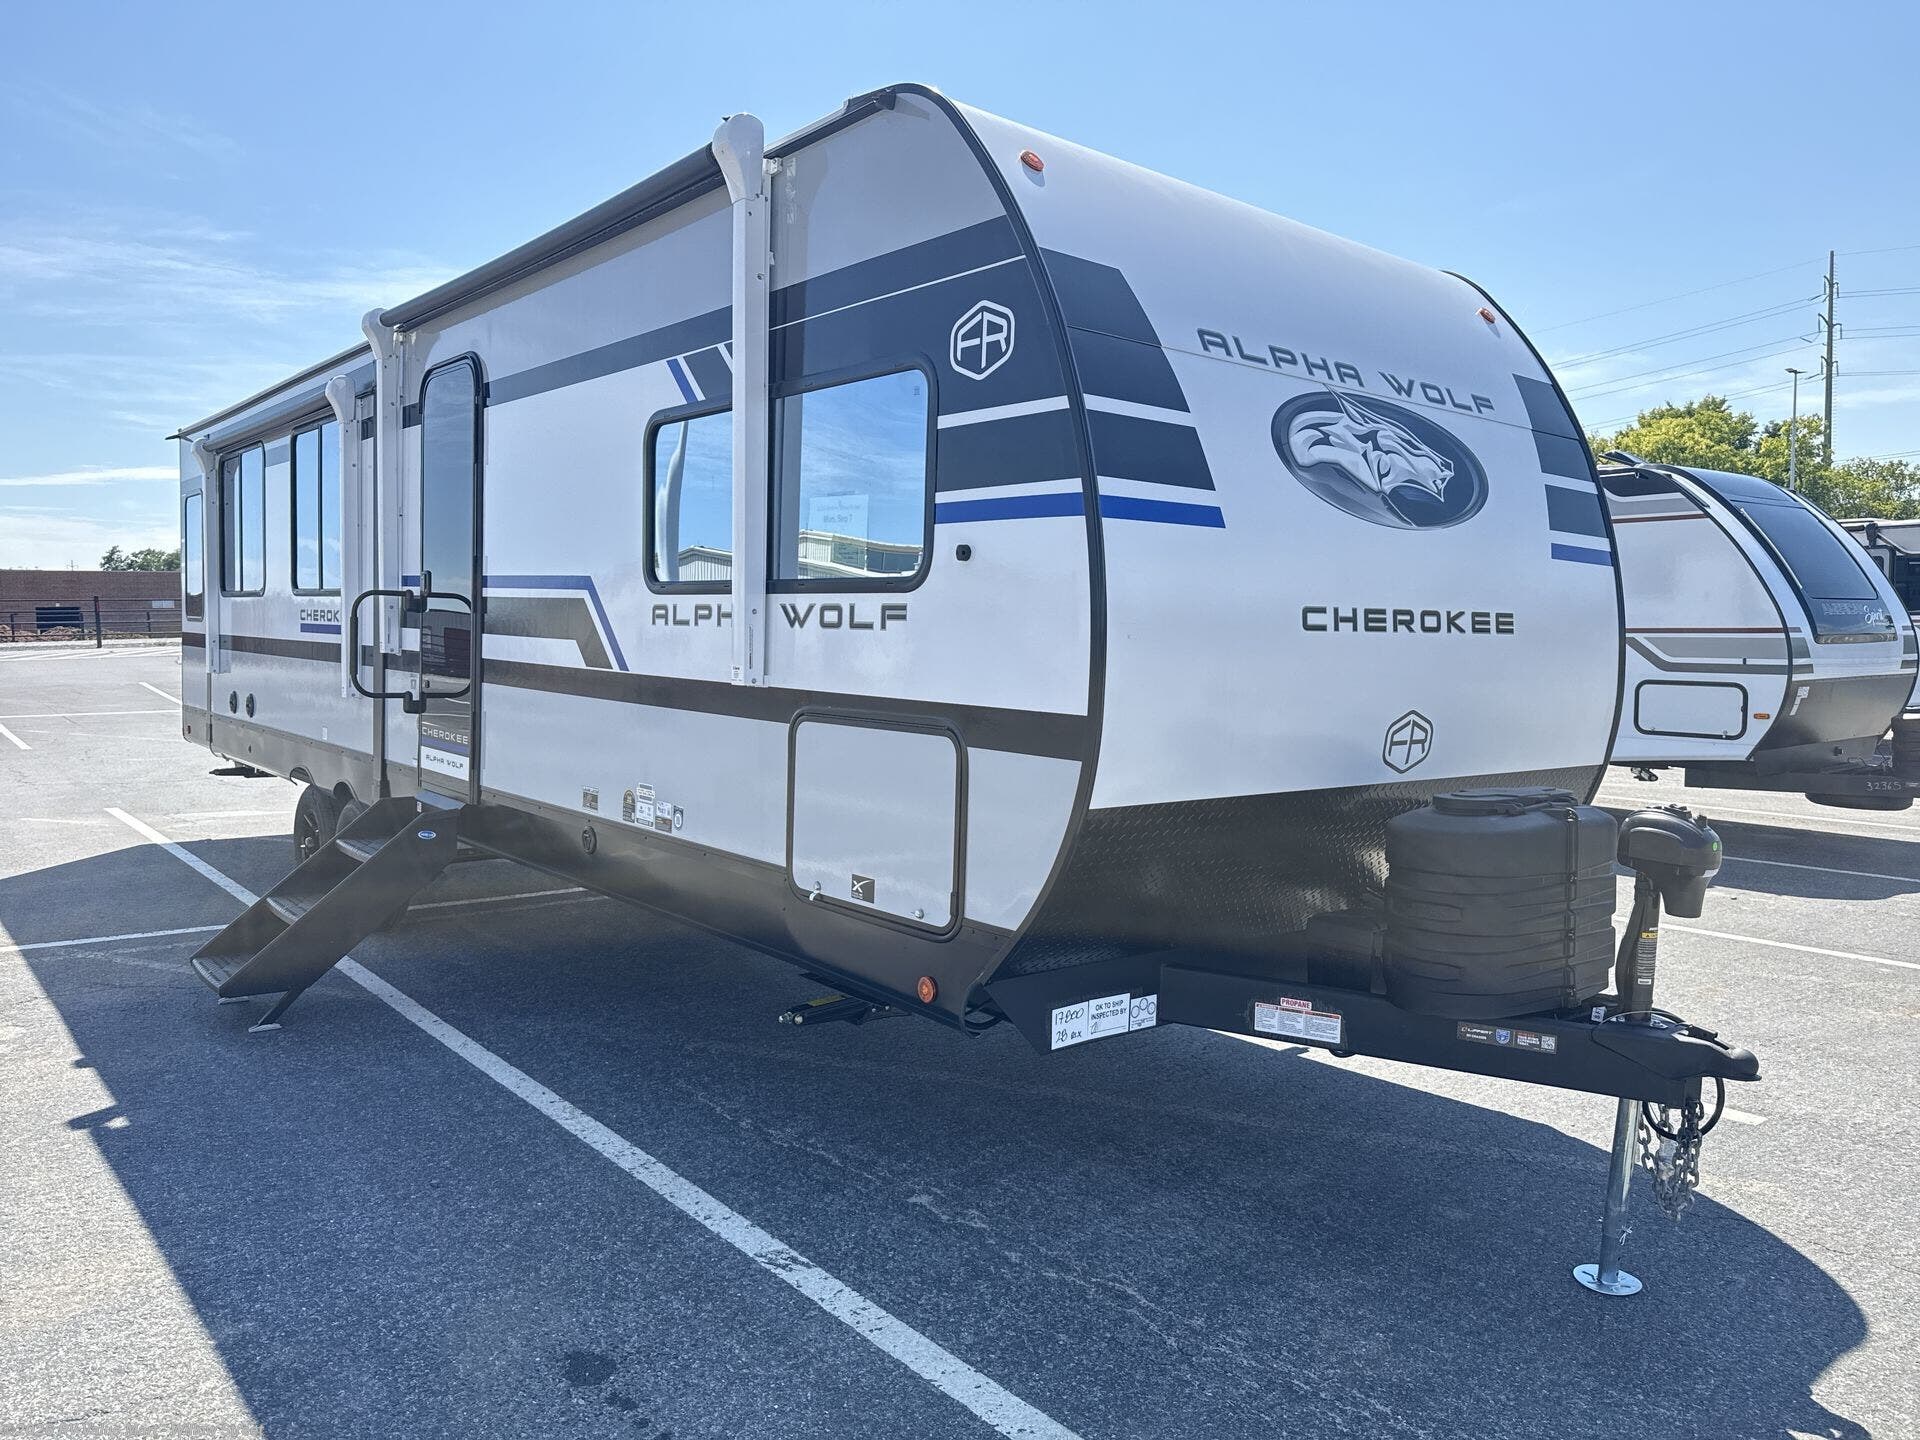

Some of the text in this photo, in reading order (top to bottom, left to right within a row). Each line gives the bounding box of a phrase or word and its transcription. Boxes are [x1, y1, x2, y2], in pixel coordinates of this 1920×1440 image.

[1197, 328, 1496, 414] ALPHA WOLF
[300, 609, 340, 622] CHEROK
[651, 603, 907, 631] ALPH WOLF
[1302, 606, 1515, 635] CHEROKEE
[421, 726, 469, 745] CHEROKEE
[425, 754, 445, 765] ALPHA
[1095, 1000, 1124, 1012] OK TO SHIP
[1281, 998, 1311, 1009] PROPANE
[1091, 1007, 1127, 1021] INSPECTED BY
